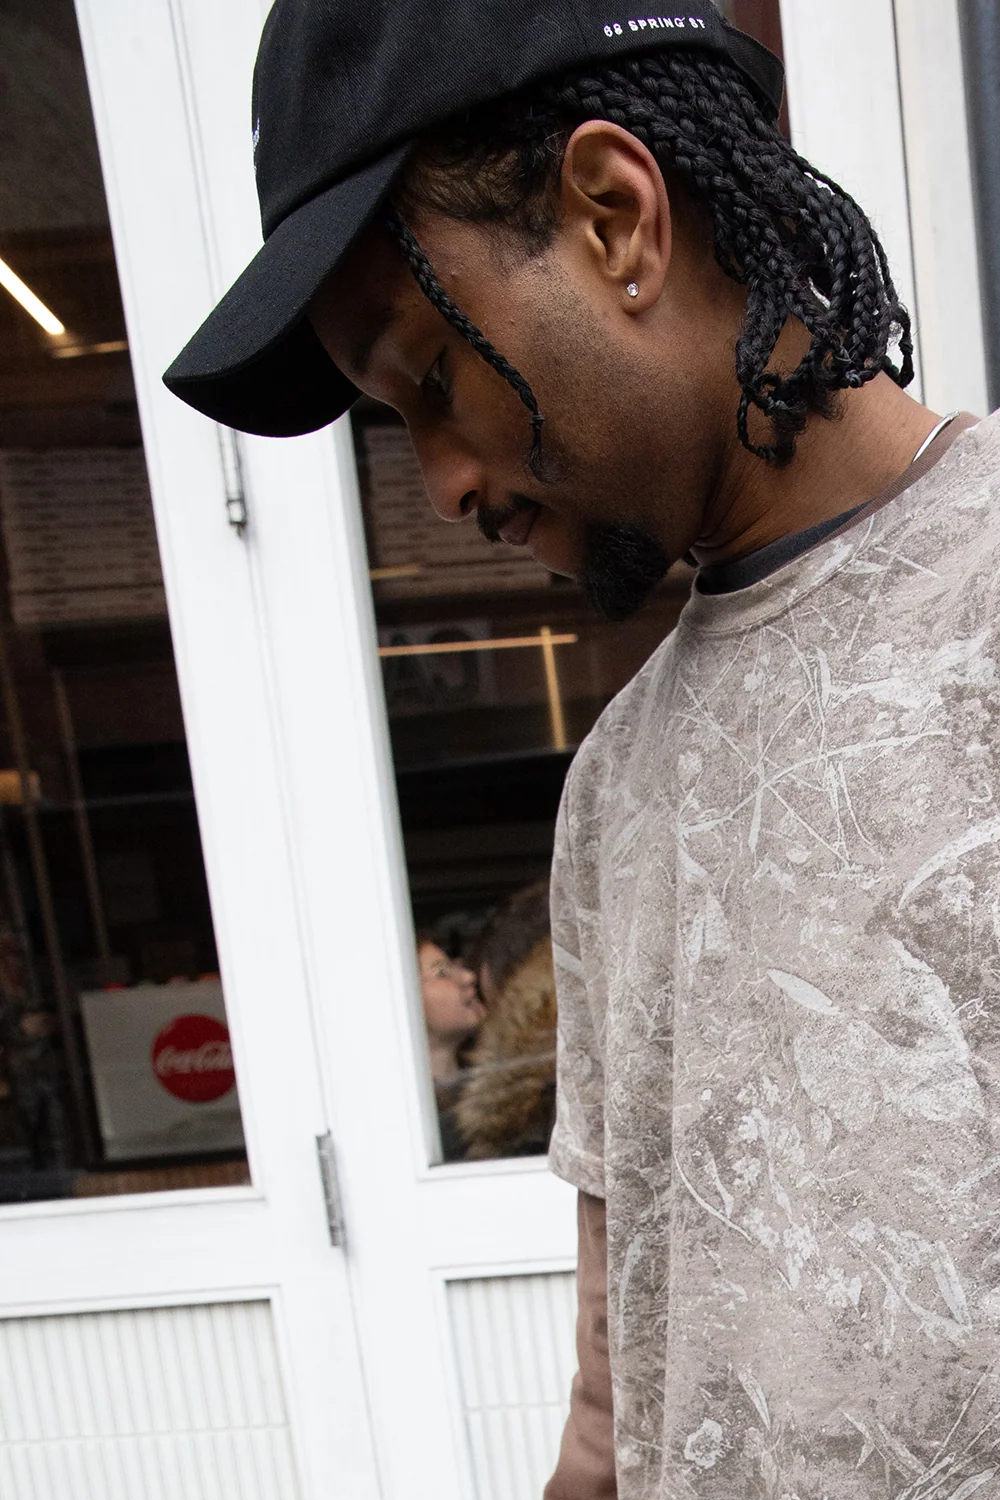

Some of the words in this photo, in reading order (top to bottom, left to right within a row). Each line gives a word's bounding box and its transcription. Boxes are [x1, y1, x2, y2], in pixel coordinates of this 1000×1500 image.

[603, 23, 623, 37] 68
[627, 17, 685, 31] SPRING
[688, 17, 705, 29] ST
